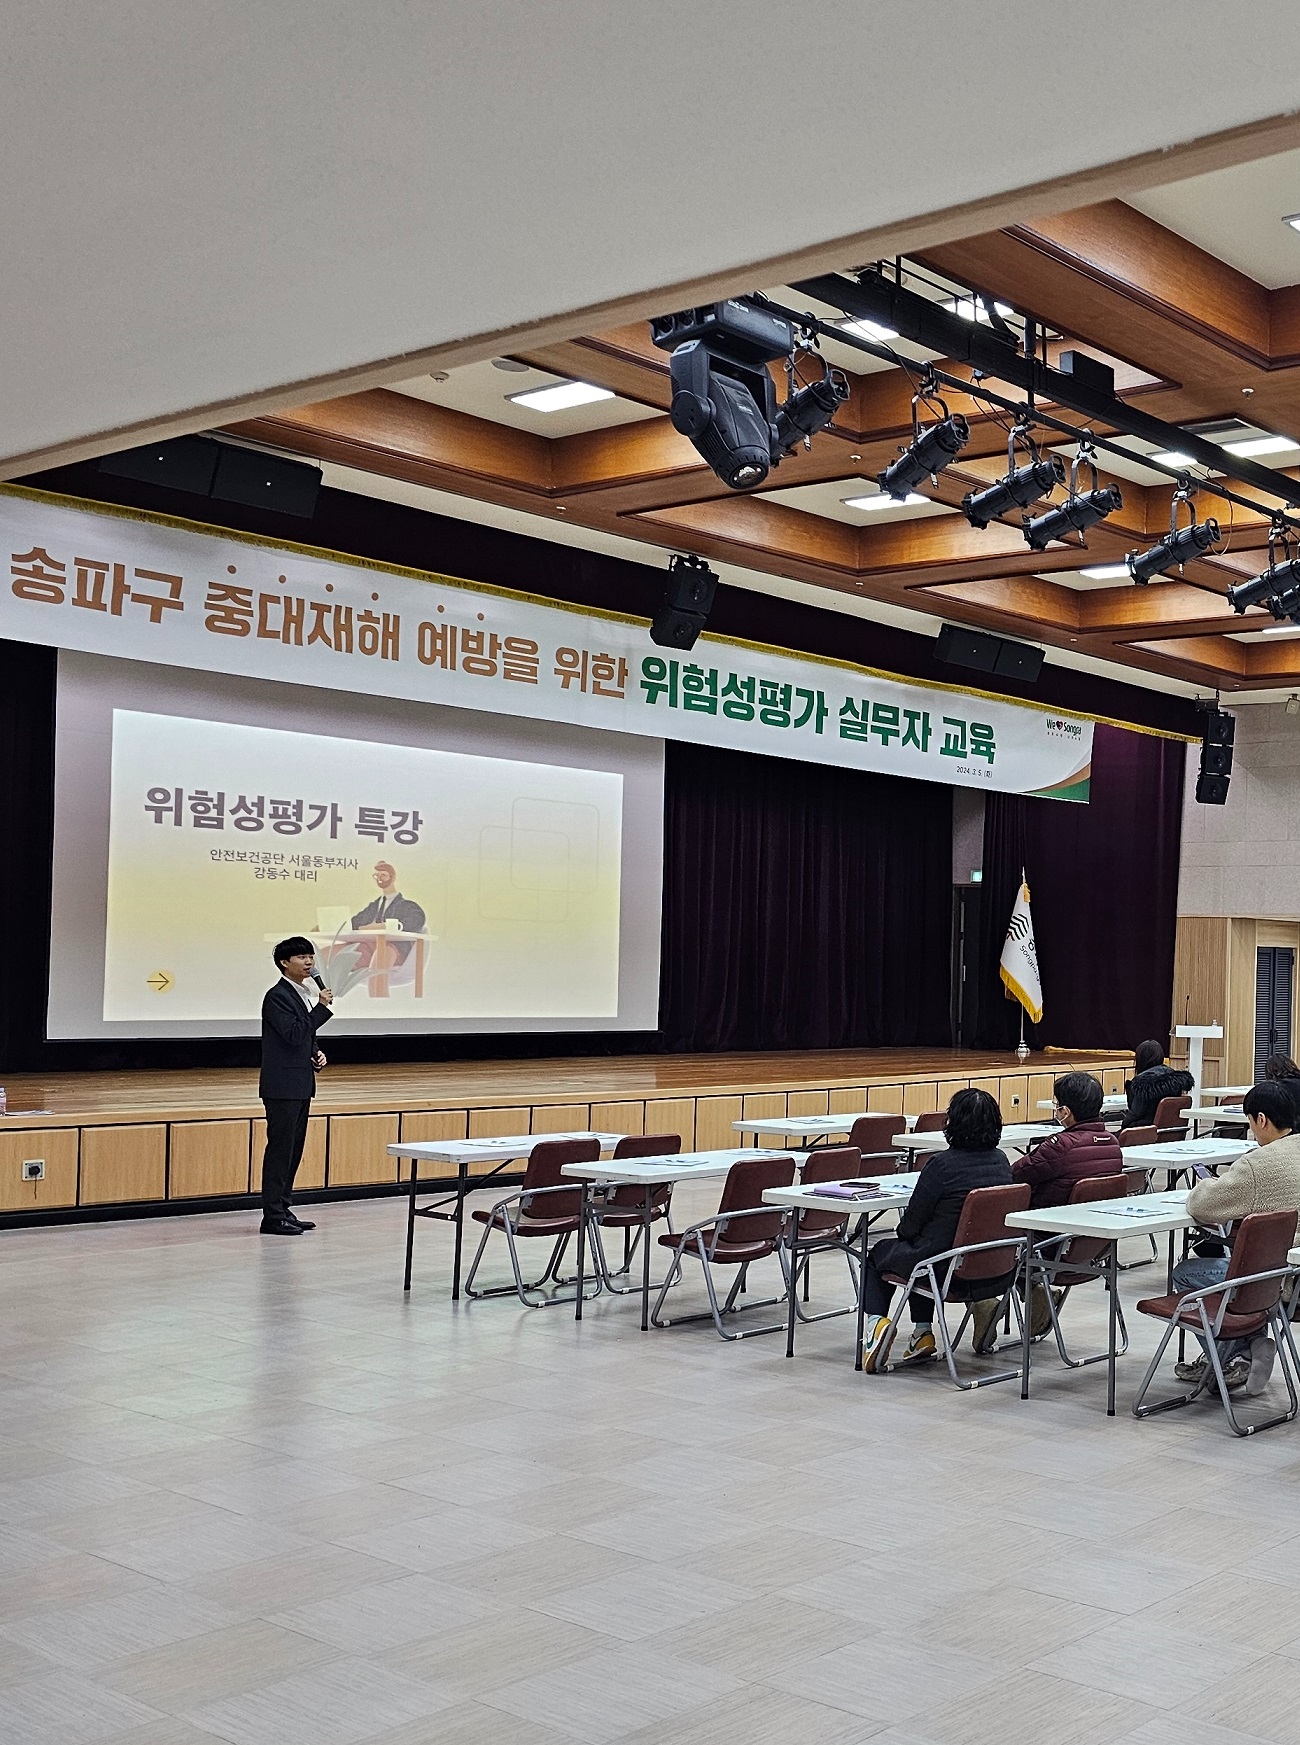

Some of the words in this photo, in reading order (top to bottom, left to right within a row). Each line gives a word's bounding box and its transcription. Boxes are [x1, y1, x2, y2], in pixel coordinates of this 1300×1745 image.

[10, 547, 184, 623] 송파구
[204, 581, 400, 661] 중대재해
[417, 619, 540, 685] 예방을
[554, 649, 628, 699] 위한
[640, 656, 828, 735] 위험성평가
[838, 696, 932, 752] 실무자
[940, 716, 996, 764] 교육
[145, 787, 342, 839] 위험성평가
[354, 806, 423, 845] 특강
[210, 849, 285, 866] 안전보건공단
[288, 854, 359, 870] 서울동부지사
[254, 867, 290, 881] 강동수
[294, 870, 318, 882] 대리
